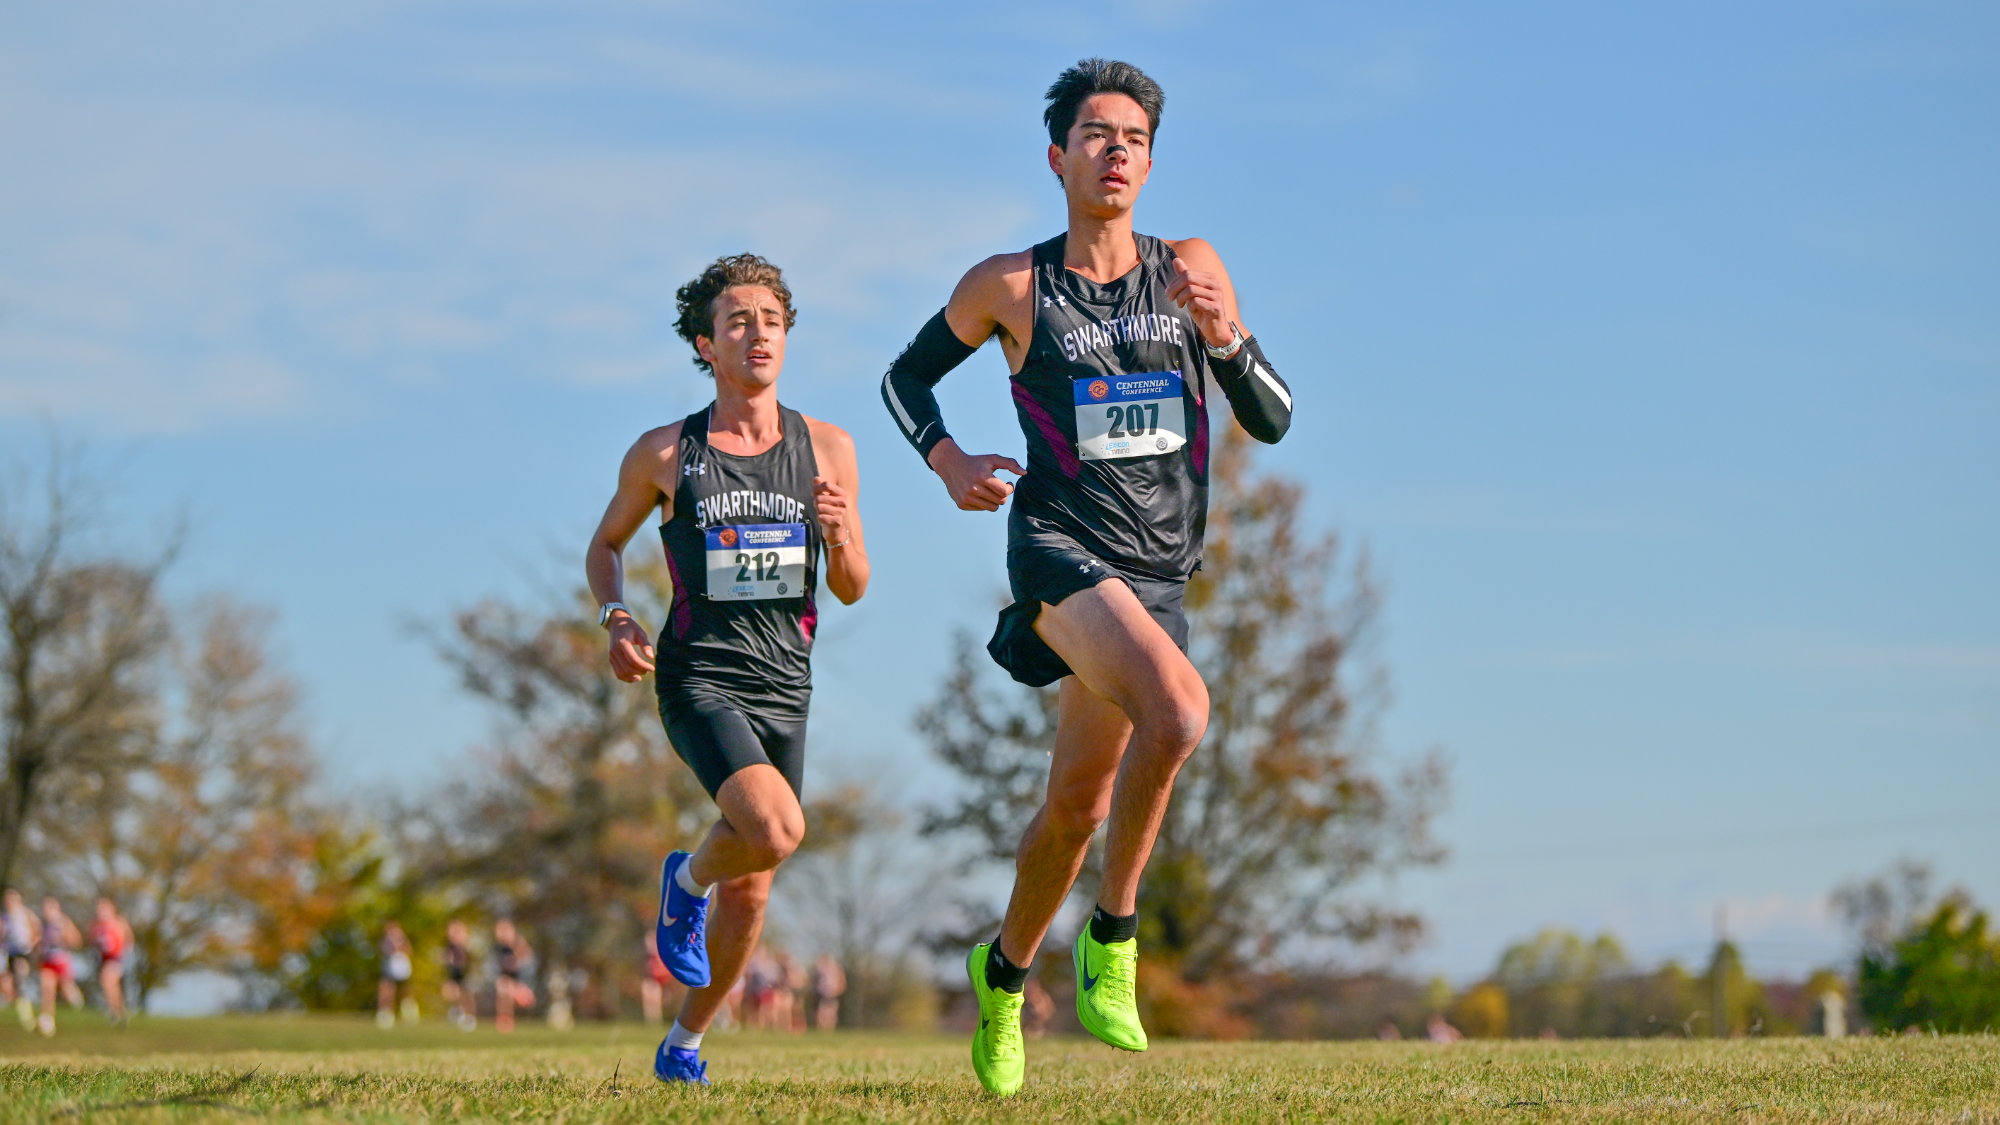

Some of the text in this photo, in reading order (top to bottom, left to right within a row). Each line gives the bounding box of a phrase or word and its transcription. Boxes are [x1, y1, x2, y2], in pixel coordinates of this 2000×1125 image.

[1063, 313, 1182, 362] SWARTHMORE
[1116, 378, 1169, 390] CENTENNIAL
[1122, 387, 1163, 396] CONFERENCE
[1106, 403, 1159, 439] 207
[695, 490, 805, 528] SWARTHMORE
[744, 530, 792, 539] CENTENNIAL
[735, 551, 781, 583] 212
